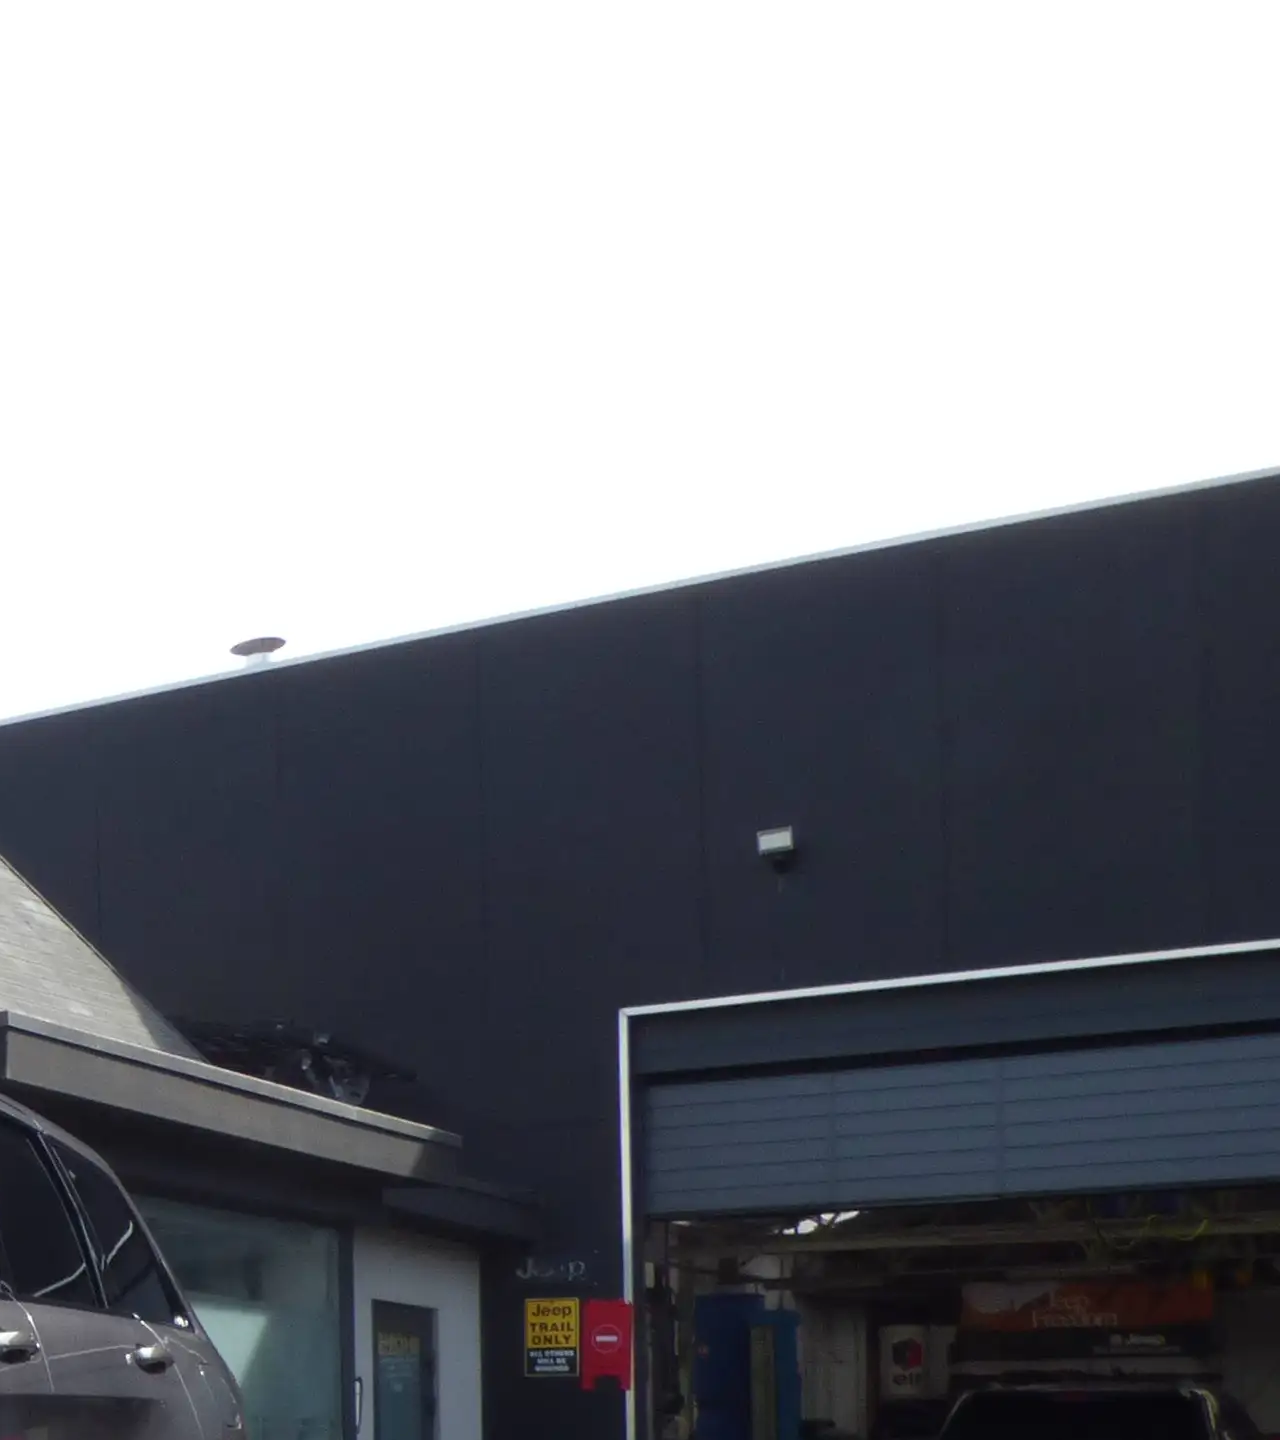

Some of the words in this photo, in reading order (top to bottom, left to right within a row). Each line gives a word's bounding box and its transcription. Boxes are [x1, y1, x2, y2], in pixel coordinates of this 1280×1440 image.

[531, 1303, 572, 1318] Jeep
[529, 1322, 574, 1332] TRAIL
[531, 1335, 572, 1346] ONLY
